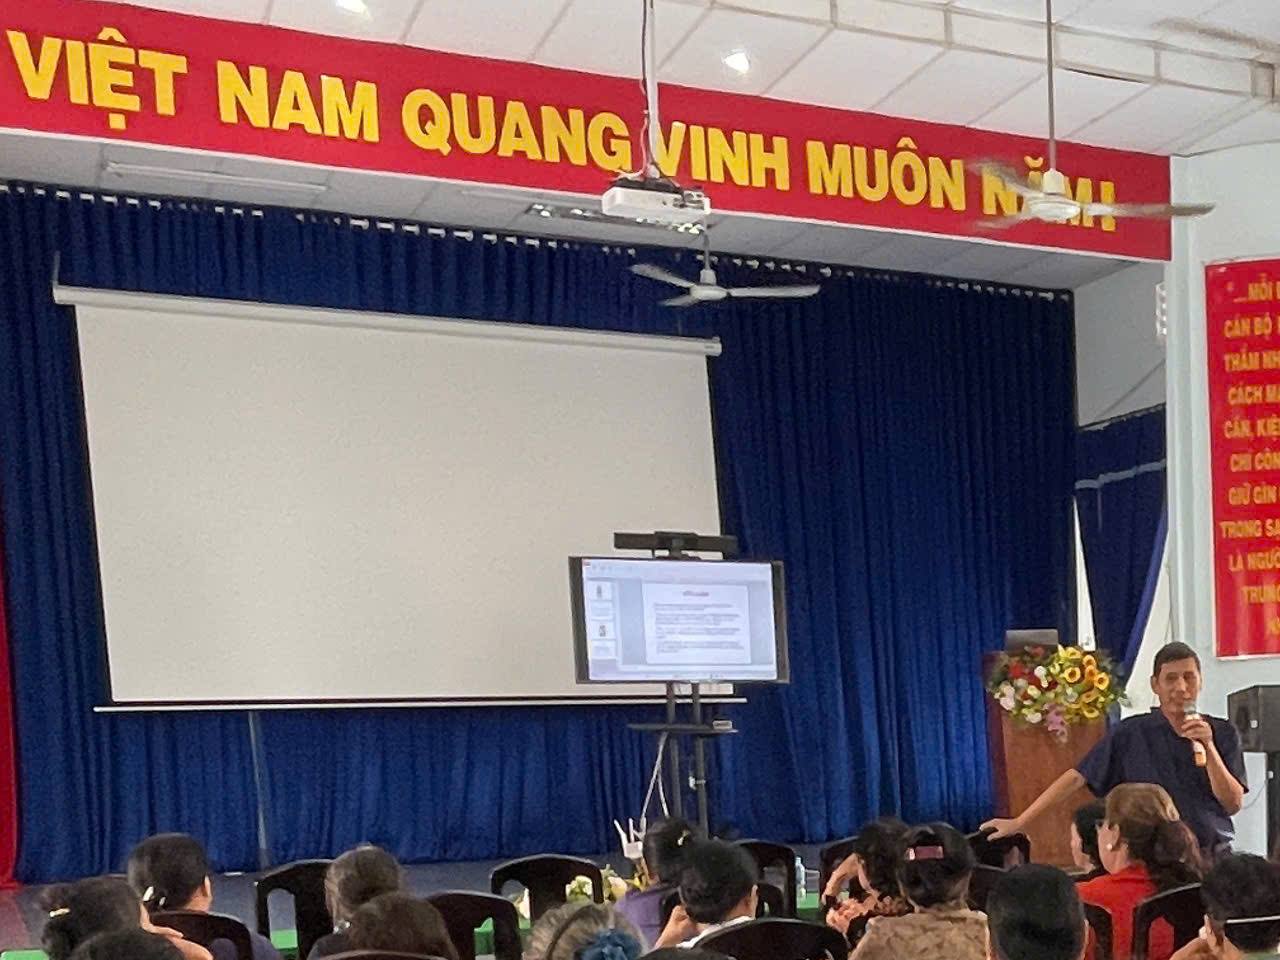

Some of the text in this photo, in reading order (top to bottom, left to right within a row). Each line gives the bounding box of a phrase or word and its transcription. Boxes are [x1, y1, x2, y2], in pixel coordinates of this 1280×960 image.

[6, 27, 188, 130] VIỆT
[216, 60, 379, 143] NAM
[402, 89, 633, 172] QUANG
[653, 121, 790, 191] VINH
[806, 137, 966, 212] MUÔN
